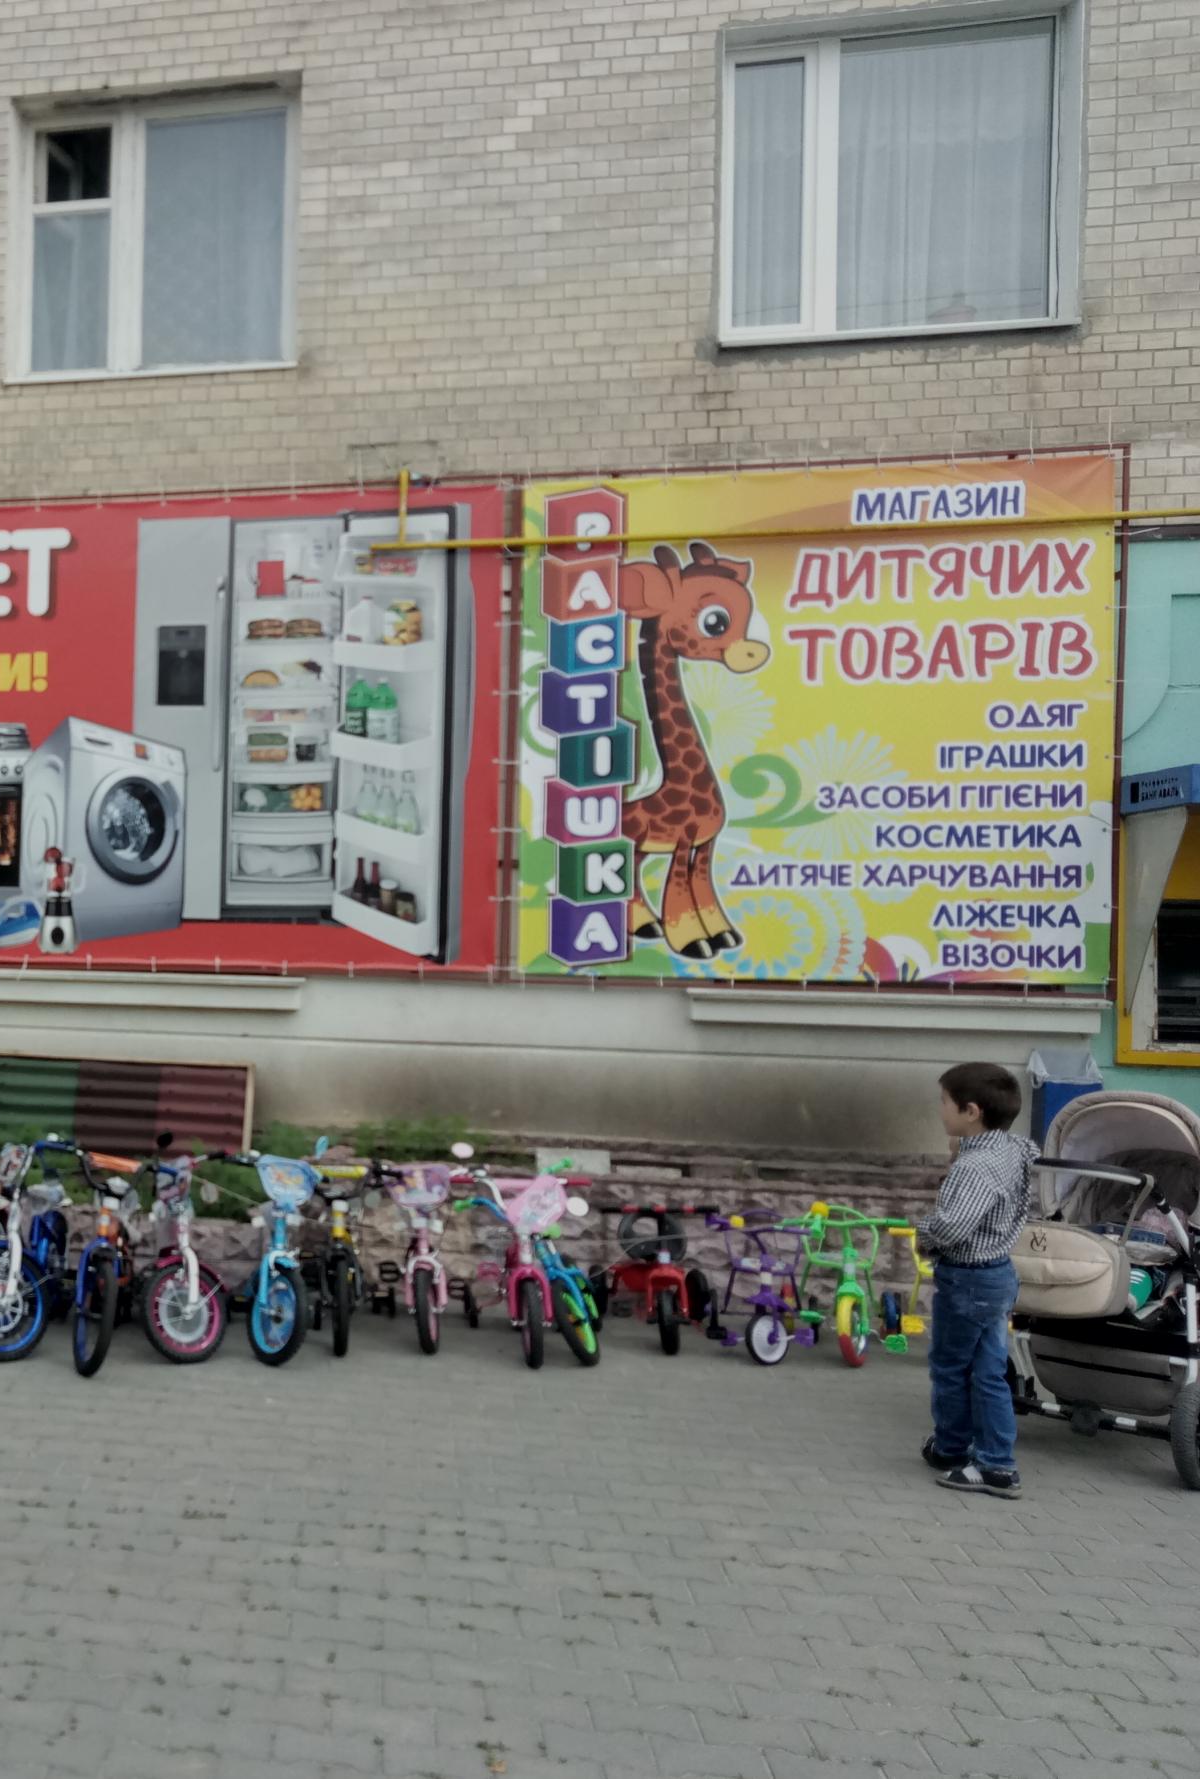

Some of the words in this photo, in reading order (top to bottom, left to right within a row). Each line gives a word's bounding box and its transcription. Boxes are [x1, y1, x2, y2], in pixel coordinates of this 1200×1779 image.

[854, 485, 1022, 523] МАГАЗИН
[788, 542, 1091, 610] ДИТЯЧИХ
[789, 621, 1094, 682] ТОВАРІВ
[988, 704, 1084, 730] ОДЯГ
[564, 510, 627, 953] РАСТІШКА
[940, 744, 1085, 770] ІГРАШКИ
[817, 784, 950, 810] ЗАСОБИ
[959, 784, 1084, 810] ГІГІЄНИ
[875, 824, 1082, 851] КОСМЕТИКА
[730, 863, 852, 890] ДИТЯЧЕ
[863, 864, 1082, 891] ХАРЧУВАННЯ
[933, 904, 1081, 929] ЛІЖЕЧКА
[941, 942, 1082, 970] ВІЗОЧКИ
